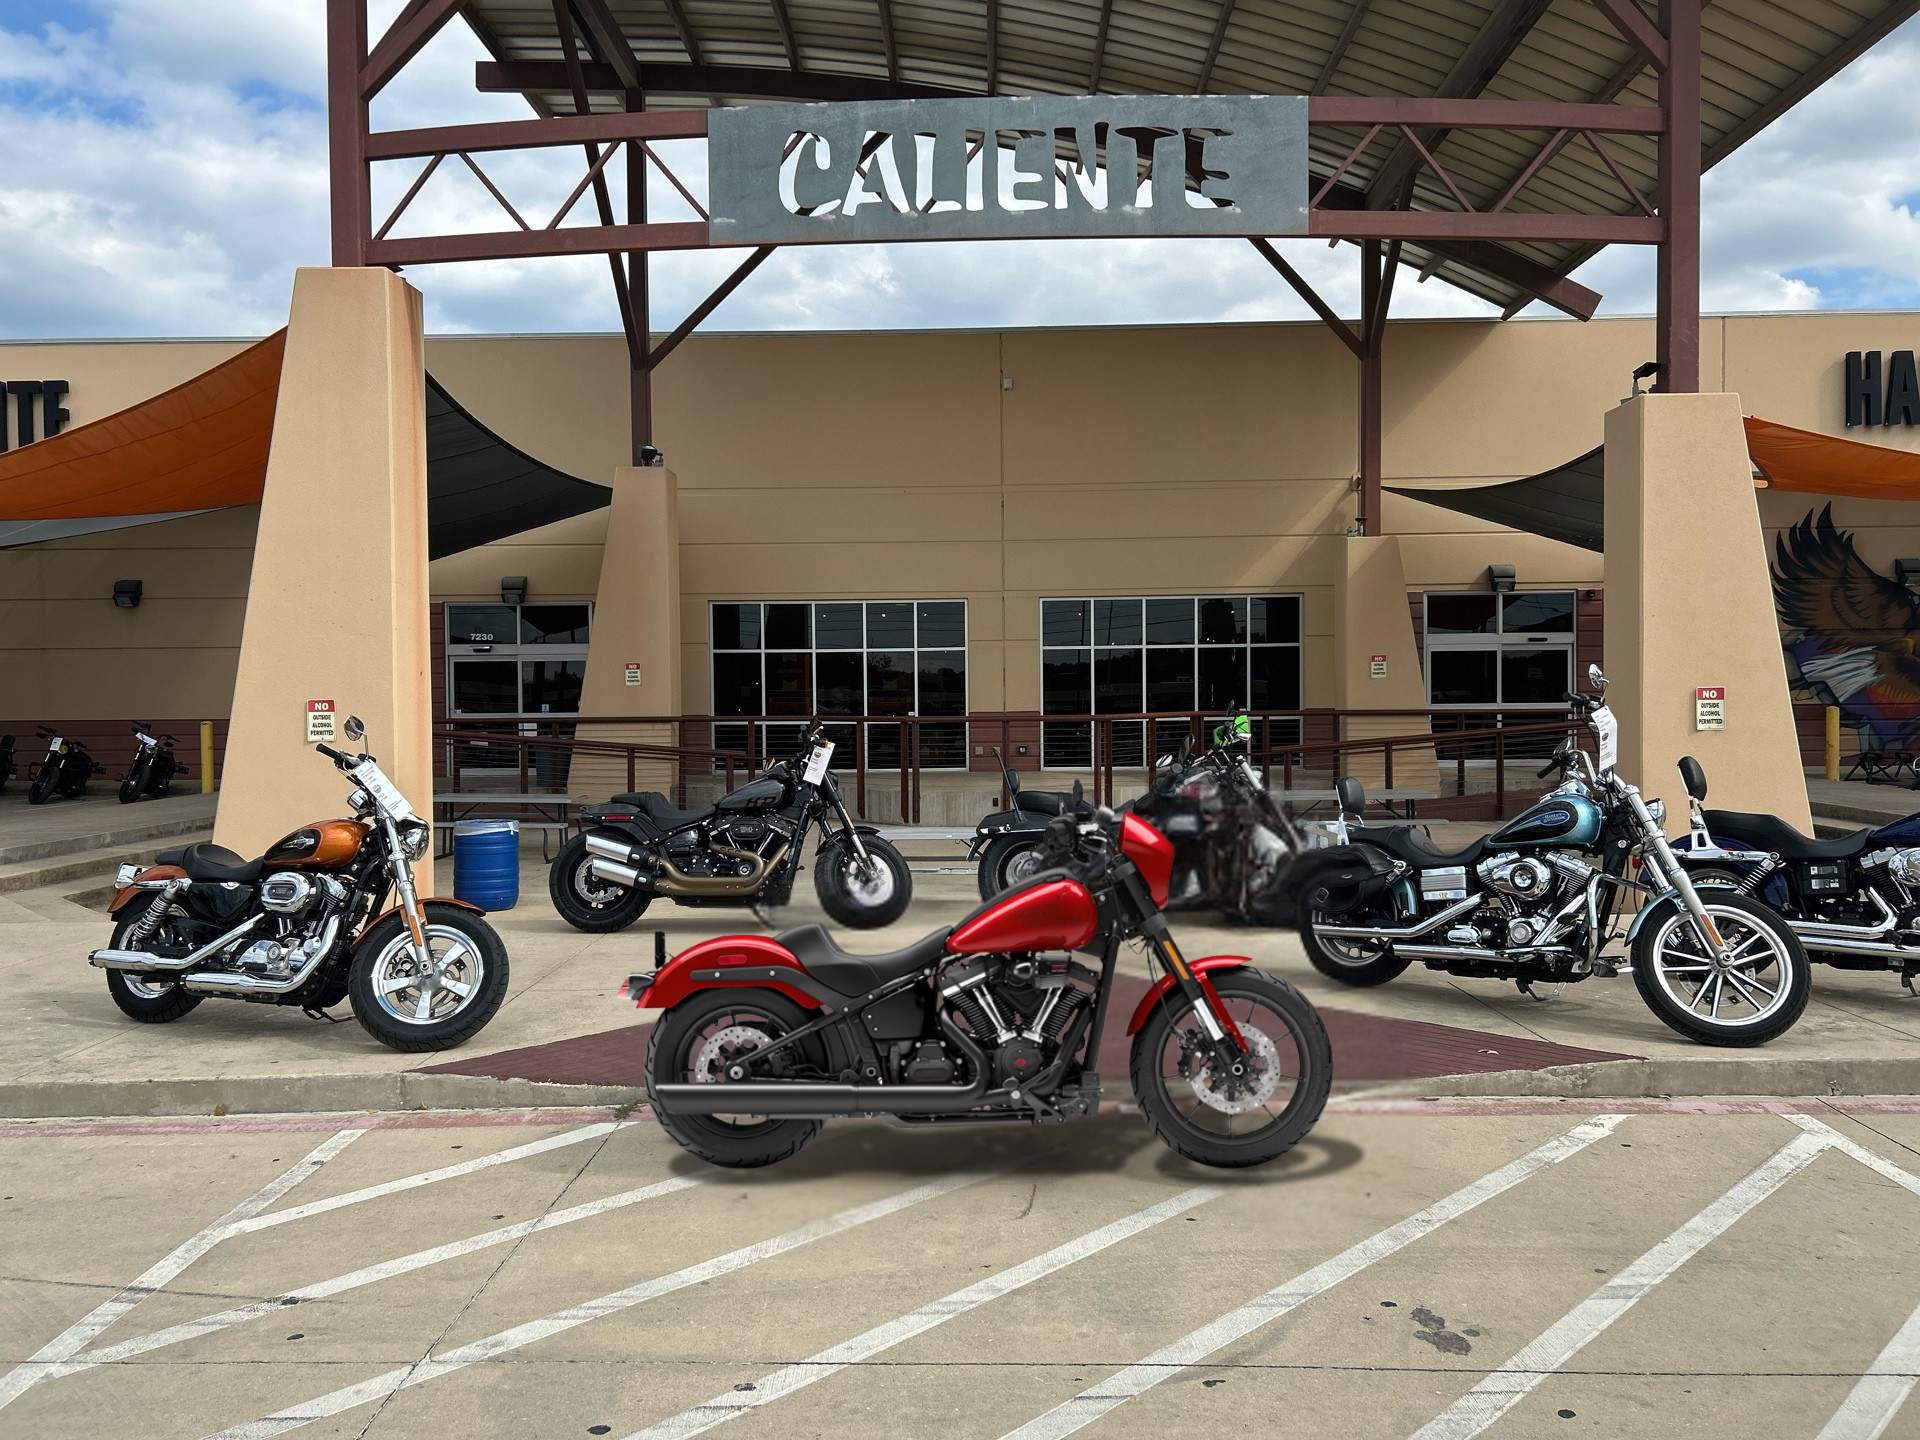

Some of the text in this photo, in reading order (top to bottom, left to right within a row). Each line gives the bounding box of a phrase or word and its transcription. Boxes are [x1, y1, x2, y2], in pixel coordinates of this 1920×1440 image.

[777, 121, 1235, 217] CALIENTE
[1845, 350, 1920, 426] HA
[470, 633, 494, 641] 7230
[1702, 690, 1718, 699] NO
[314, 702, 329, 711] NO
